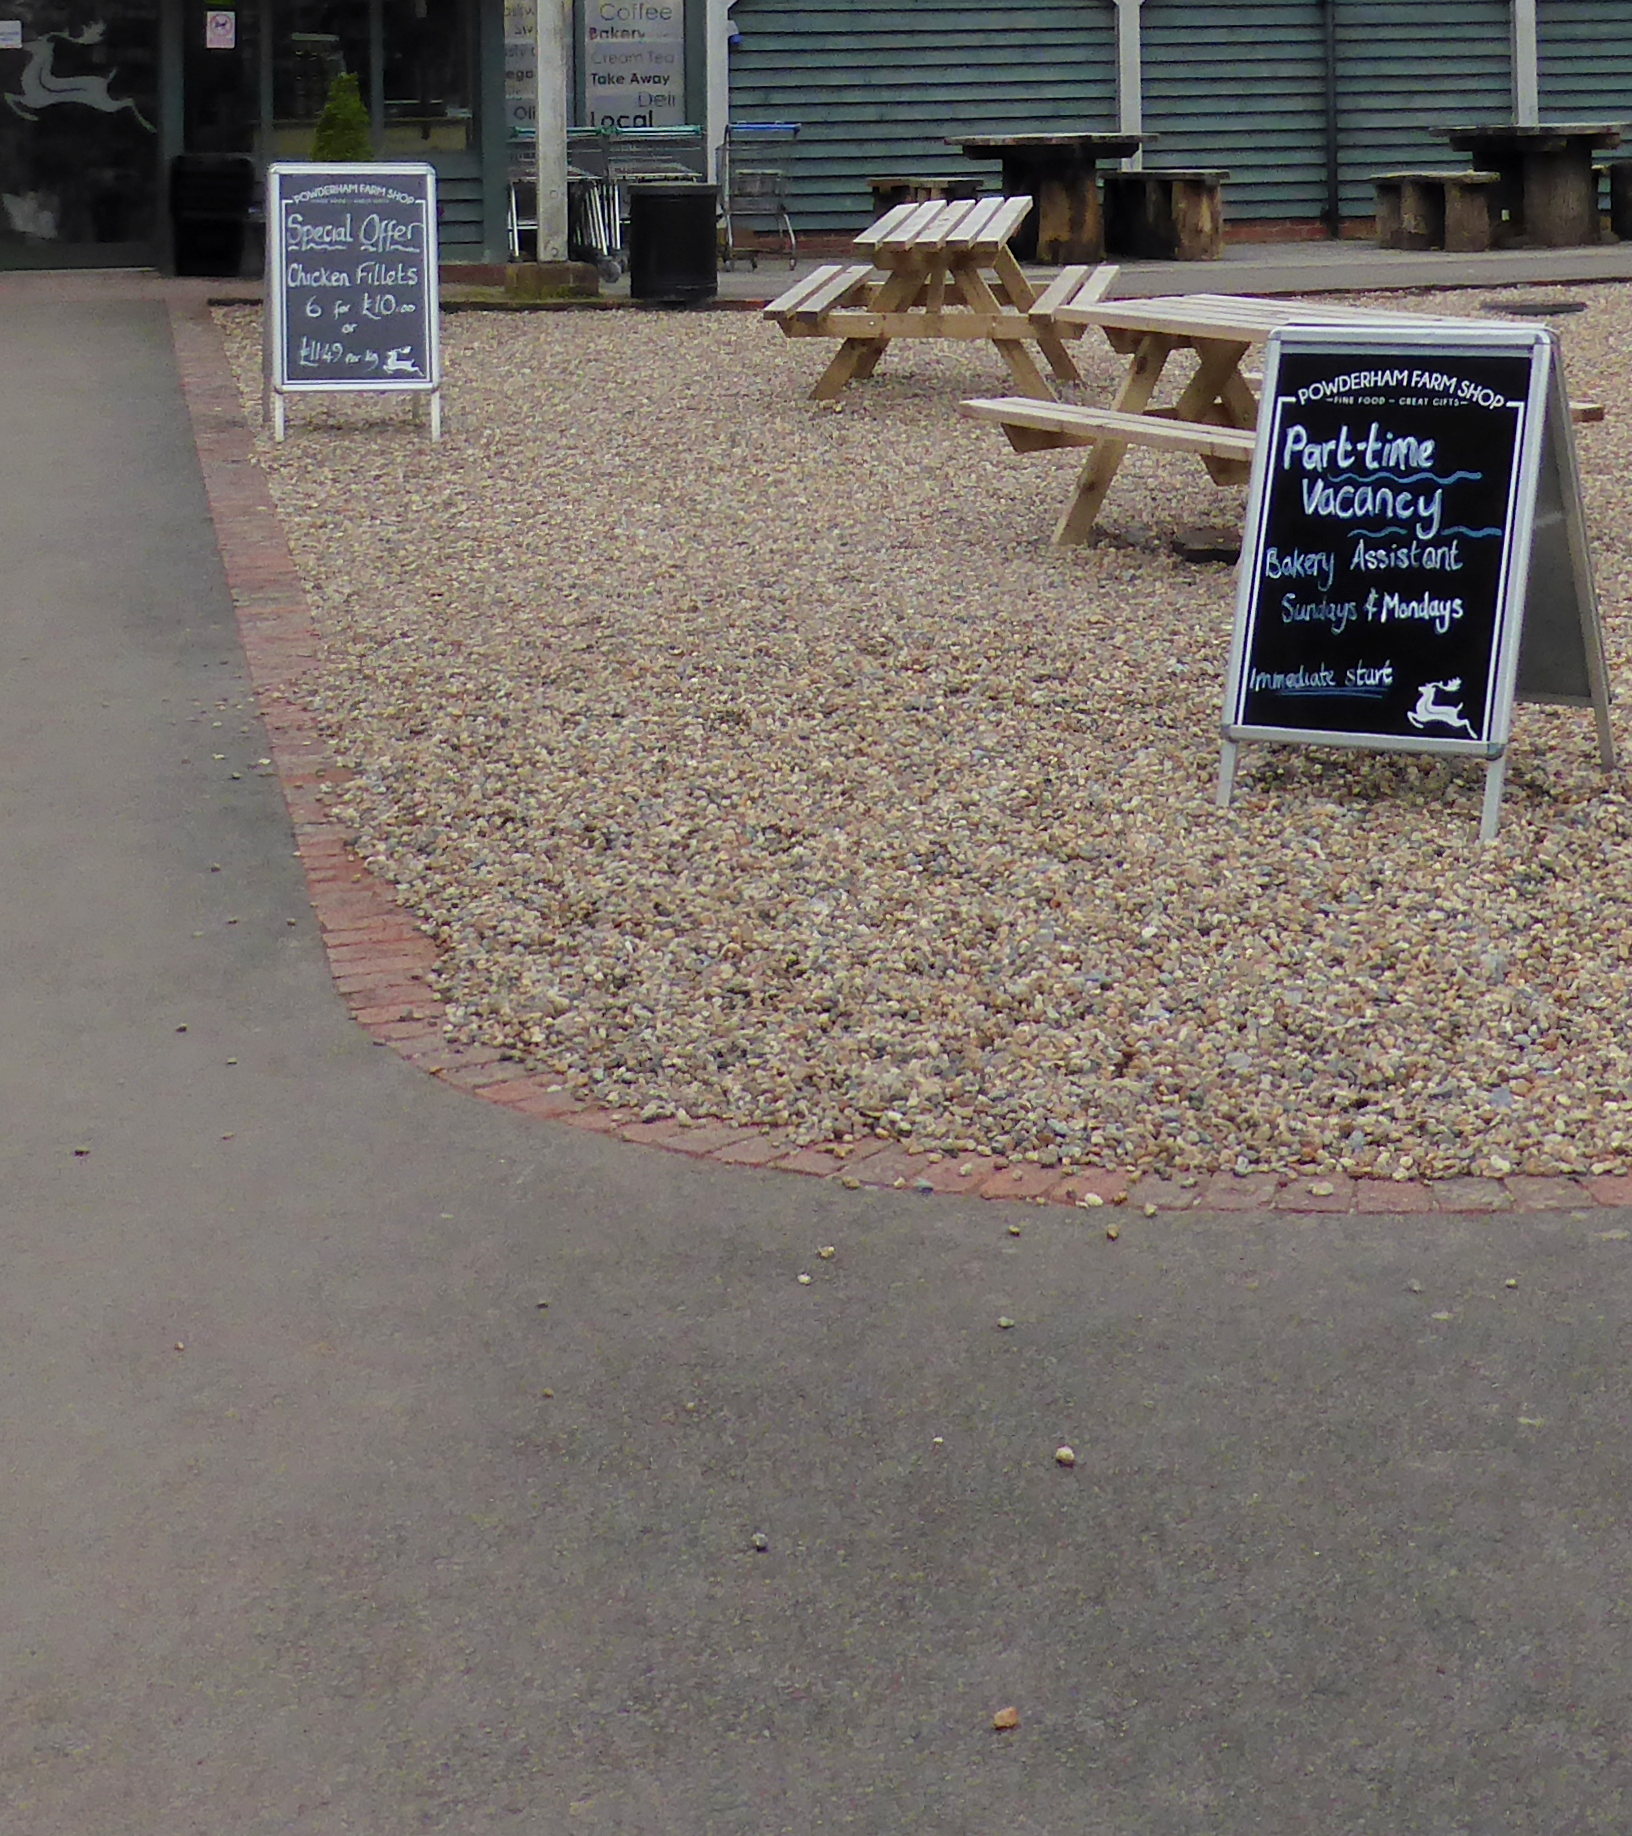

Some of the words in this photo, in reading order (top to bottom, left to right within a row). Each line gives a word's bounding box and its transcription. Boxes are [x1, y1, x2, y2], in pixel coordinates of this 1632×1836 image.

[599, 2, 673, 21] Coffee
[590, 51, 643, 65] Cream
[647, 50, 675, 65] Tea
[591, 72, 625, 86] Take
[629, 72, 670, 87] Away
[637, 90, 676, 108] Deli
[590, 109, 654, 128] Local
[293, 184, 358, 204] POWDERHAM
[359, 183, 386, 197] FARM
[386, 189, 414, 205] SHOP
[287, 213, 353, 251] Special
[360, 213, 424, 252] Offer
[287, 263, 351, 287] Chicken
[356, 261, 418, 286] Fillets
[305, 295, 323, 318] 6
[333, 300, 351, 320] for
[341, 322, 358, 334] or
[1297, 369, 1409, 406] POWDERHAM
[1410, 370, 1458, 395] FARM
[1457, 380, 1505, 410] SHOP
[1357, 396, 1386, 405] FOOD
[1283, 422, 1436, 471] Part-time
[1301, 478, 1443, 540] Vacancy
[1265, 547, 1336, 592] Bakery
[1349, 538, 1464, 573] Assistant
[1281, 593, 1358, 635] Sundays
[1380, 590, 1464, 634] Mondays
[1249, 665, 1337, 692] Immediate
[1344, 658, 1394, 687] start
